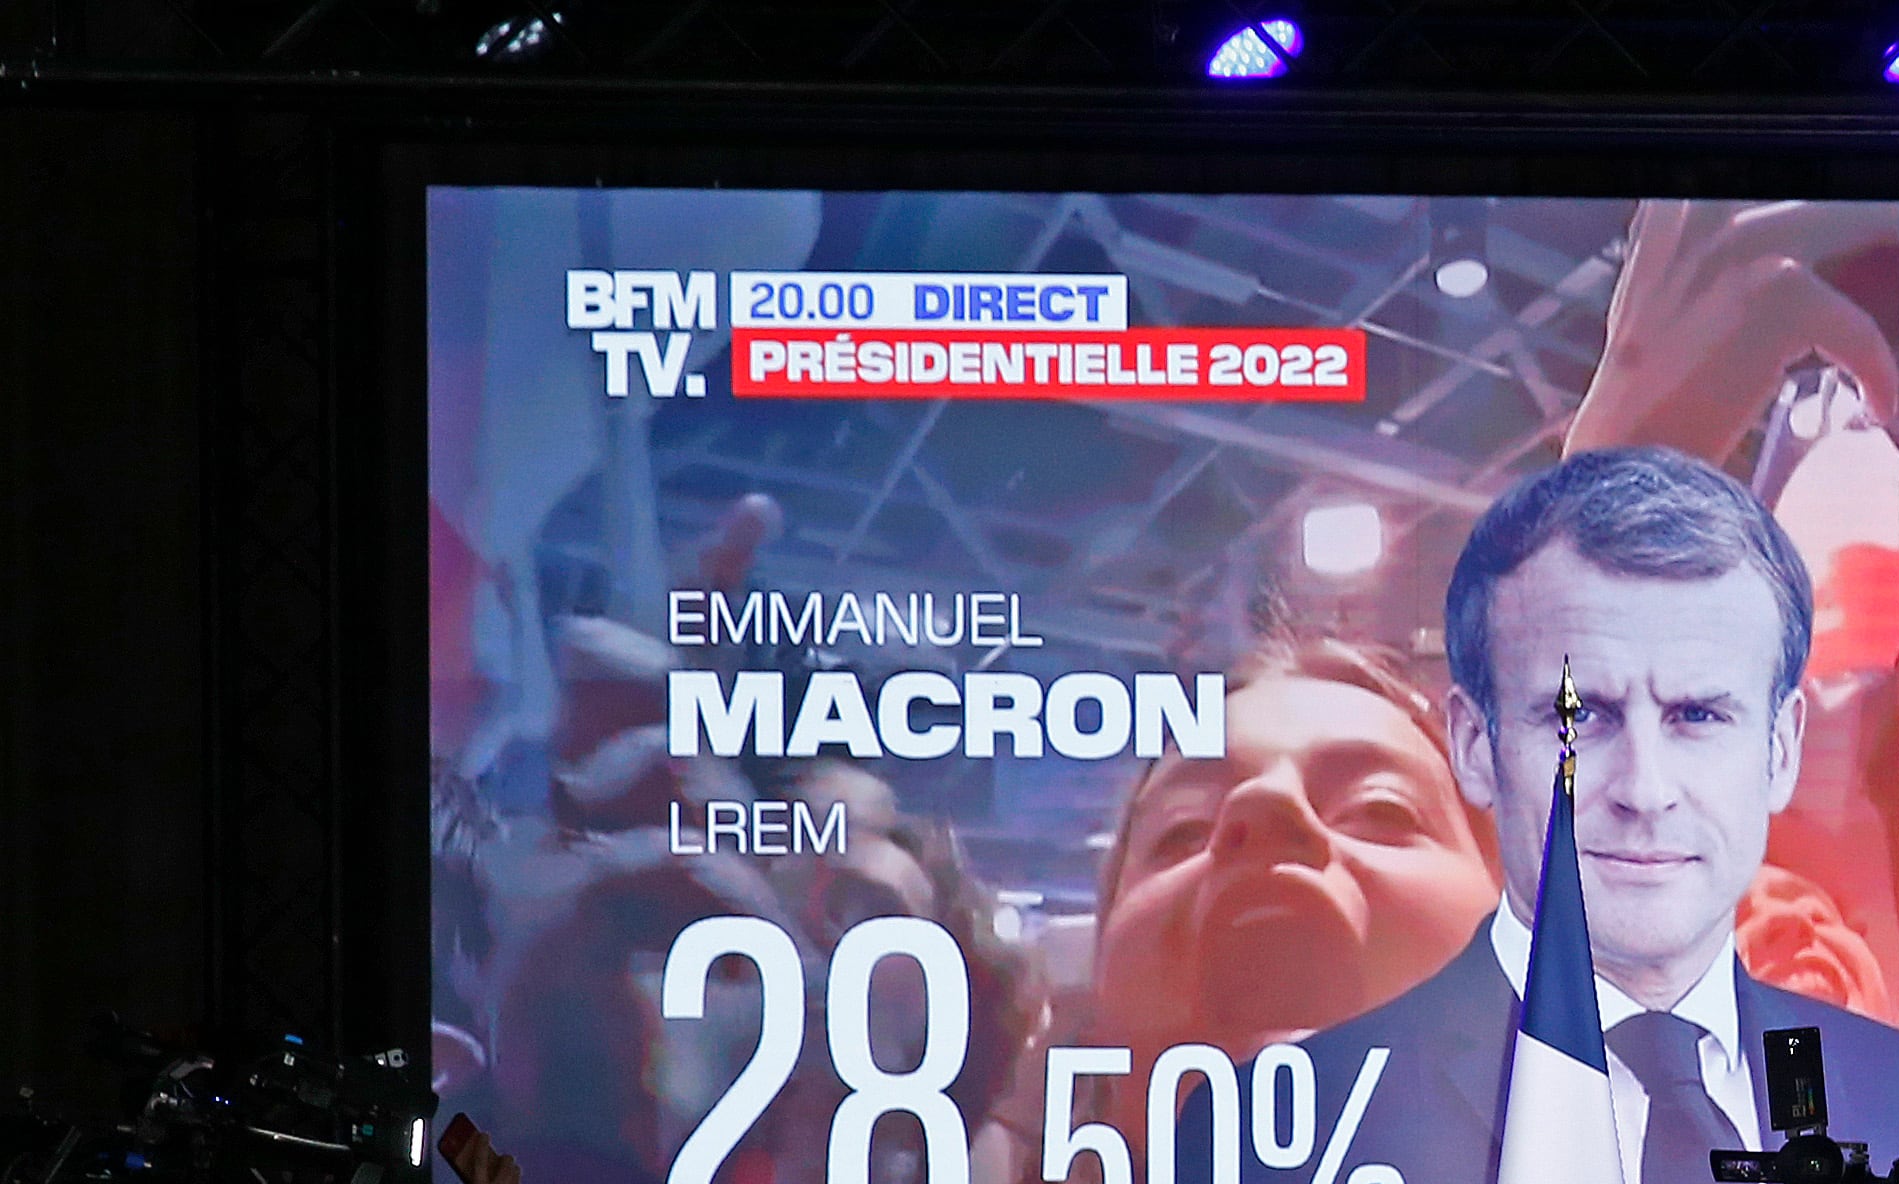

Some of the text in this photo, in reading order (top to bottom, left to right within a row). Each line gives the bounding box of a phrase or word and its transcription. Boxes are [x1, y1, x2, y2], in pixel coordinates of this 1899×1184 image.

[567, 271, 716, 330] BFM
[750, 282, 1110, 323] 20.00 DIRECT
[592, 333, 706, 397] TV.
[749, 334, 1349, 387] PRÉSIDENTIELLE 2022
[669, 592, 1044, 648] EMMANUEL
[669, 671, 1226, 759] MACRON
[669, 801, 849, 855] LREM
